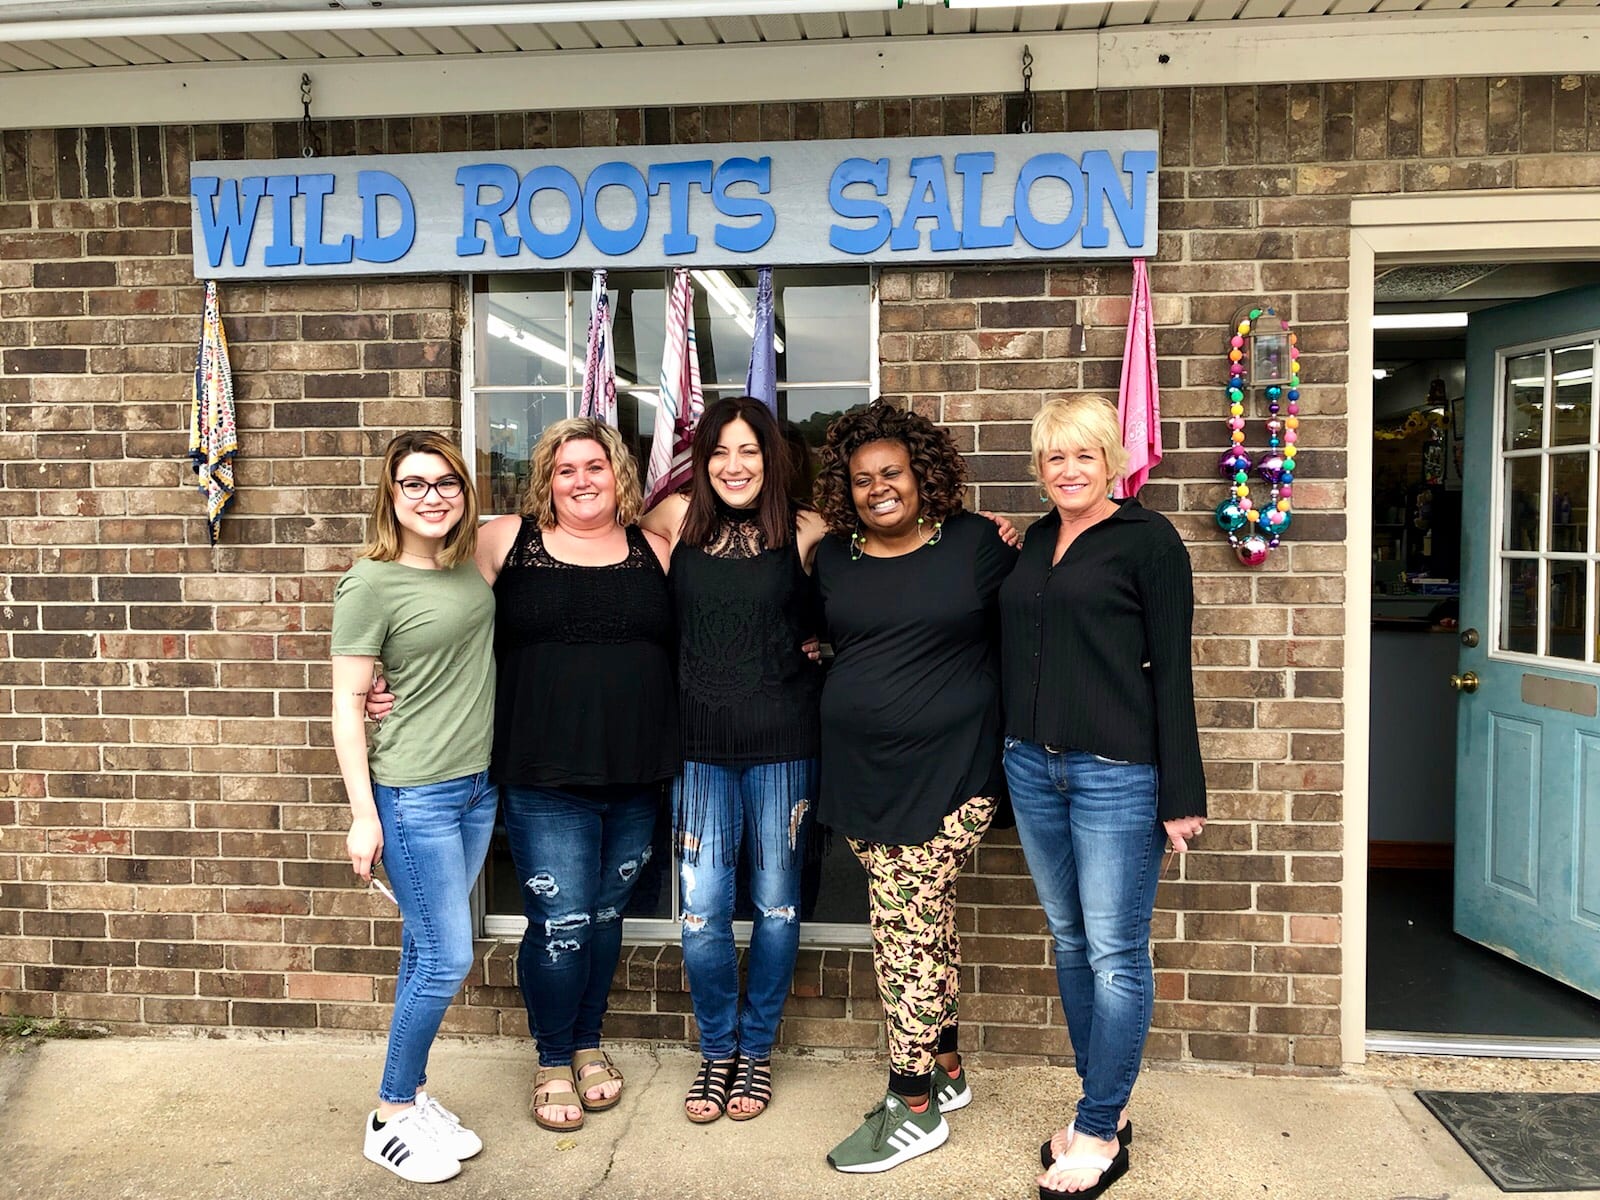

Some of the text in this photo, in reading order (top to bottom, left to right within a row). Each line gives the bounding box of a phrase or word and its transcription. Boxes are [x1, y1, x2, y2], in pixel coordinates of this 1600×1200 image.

[191, 150, 1157, 267] WILD ROOTS SALON
